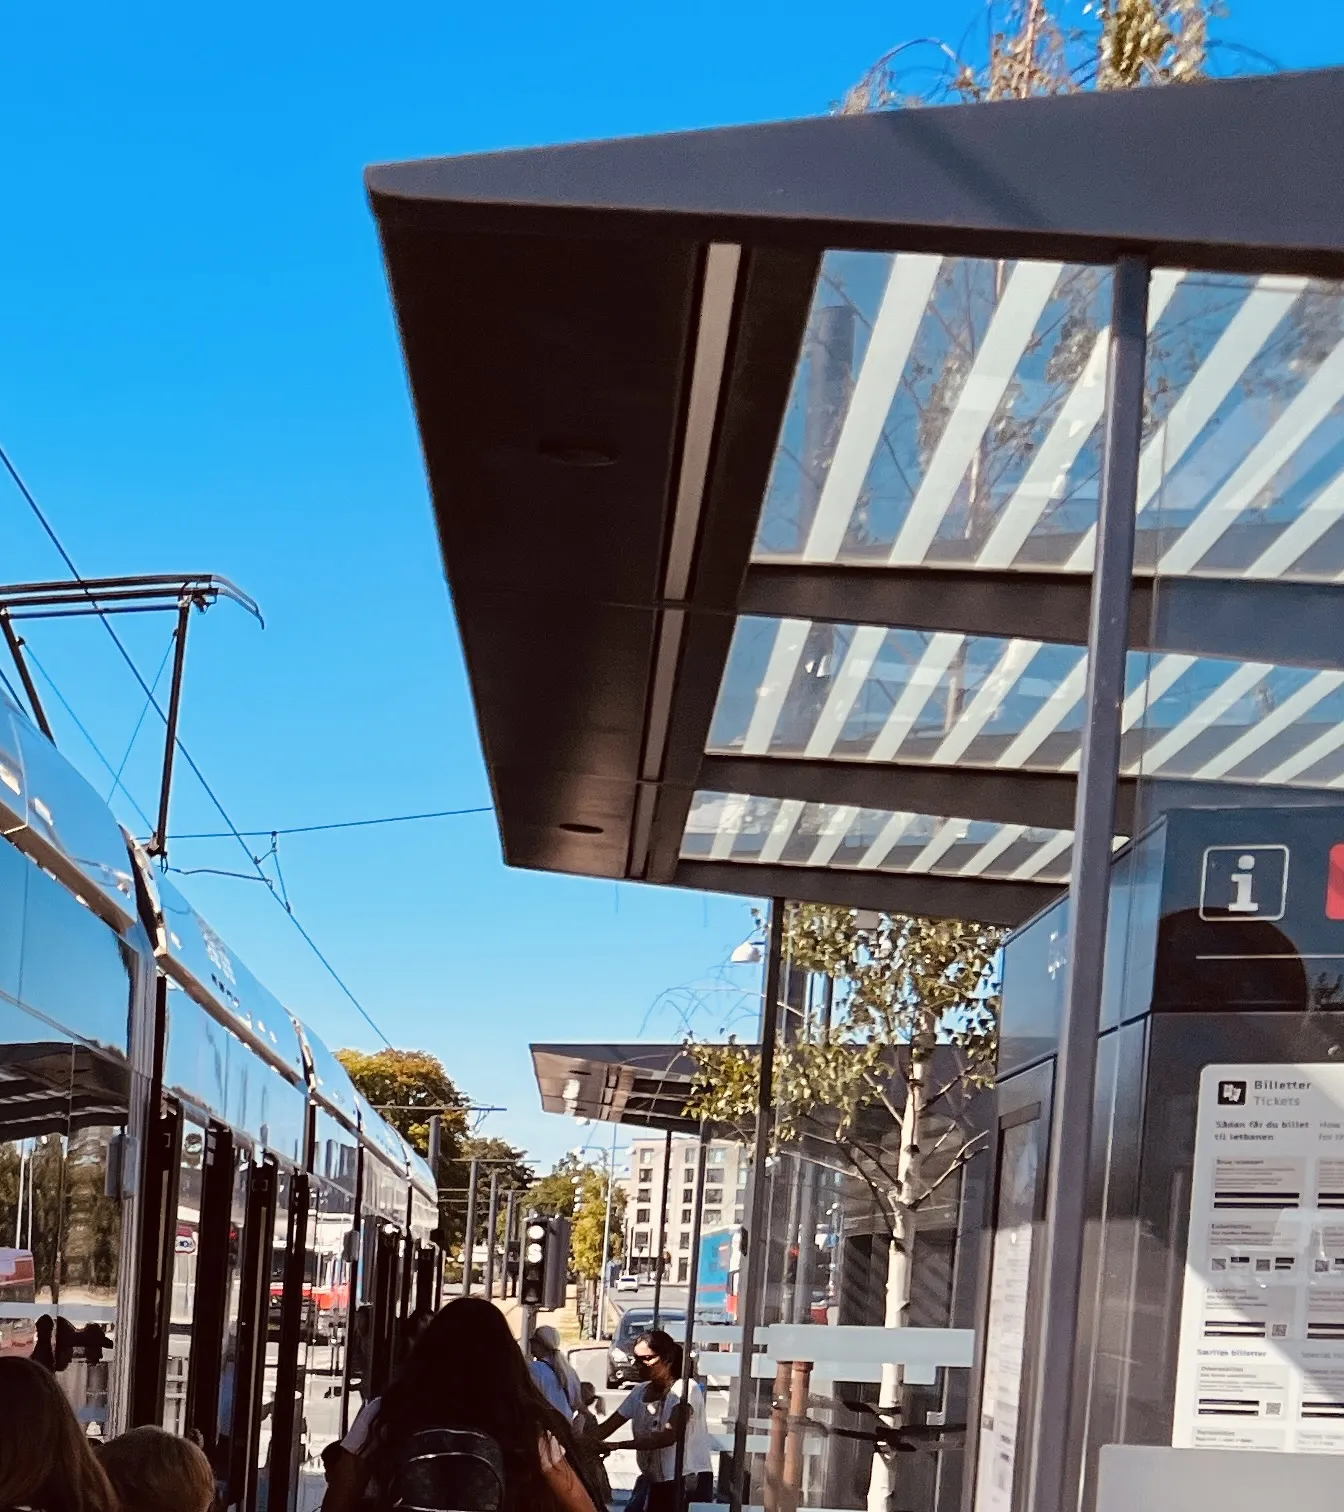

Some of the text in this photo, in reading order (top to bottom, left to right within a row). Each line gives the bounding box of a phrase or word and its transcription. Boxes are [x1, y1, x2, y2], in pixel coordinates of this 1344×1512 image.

[1254, 1080, 1312, 1090] Billetter
[1254, 1096, 1301, 1106] Tickets
[1266, 1120, 1278, 1129] du
